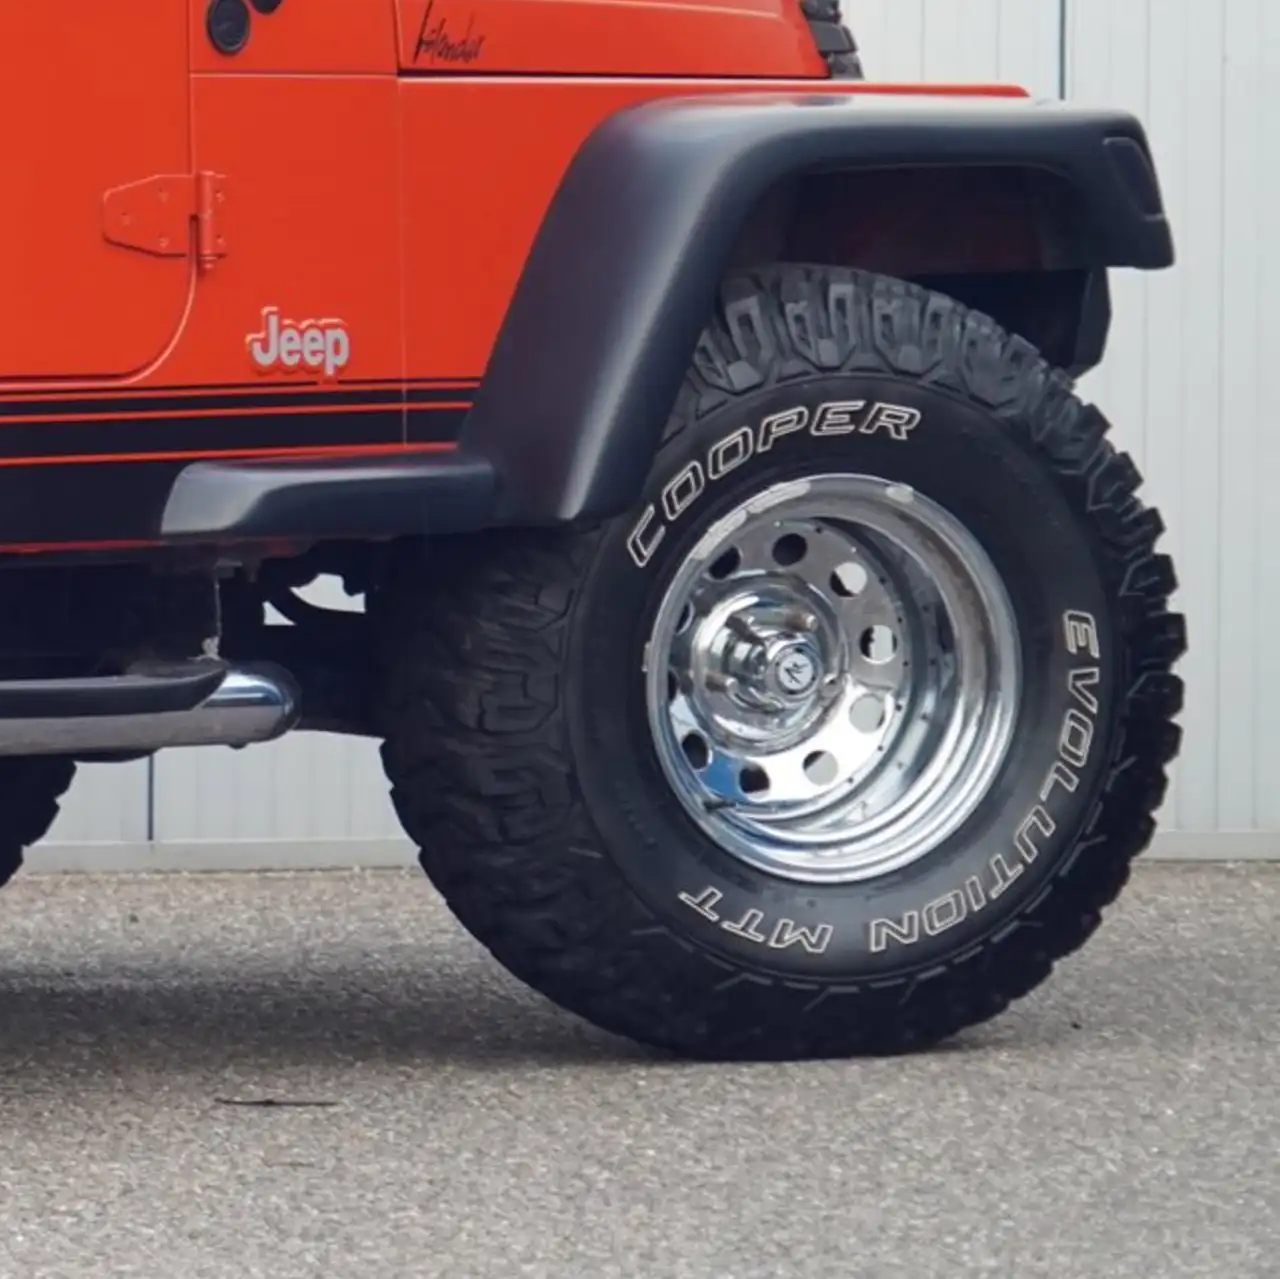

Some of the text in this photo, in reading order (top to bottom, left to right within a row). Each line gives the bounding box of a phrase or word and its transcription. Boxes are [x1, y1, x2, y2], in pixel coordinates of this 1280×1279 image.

[250, 312, 350, 377] Jeep
[627, 400, 921, 568] COOPER
[678, 609, 1101, 953] EVOLUTION MTT
